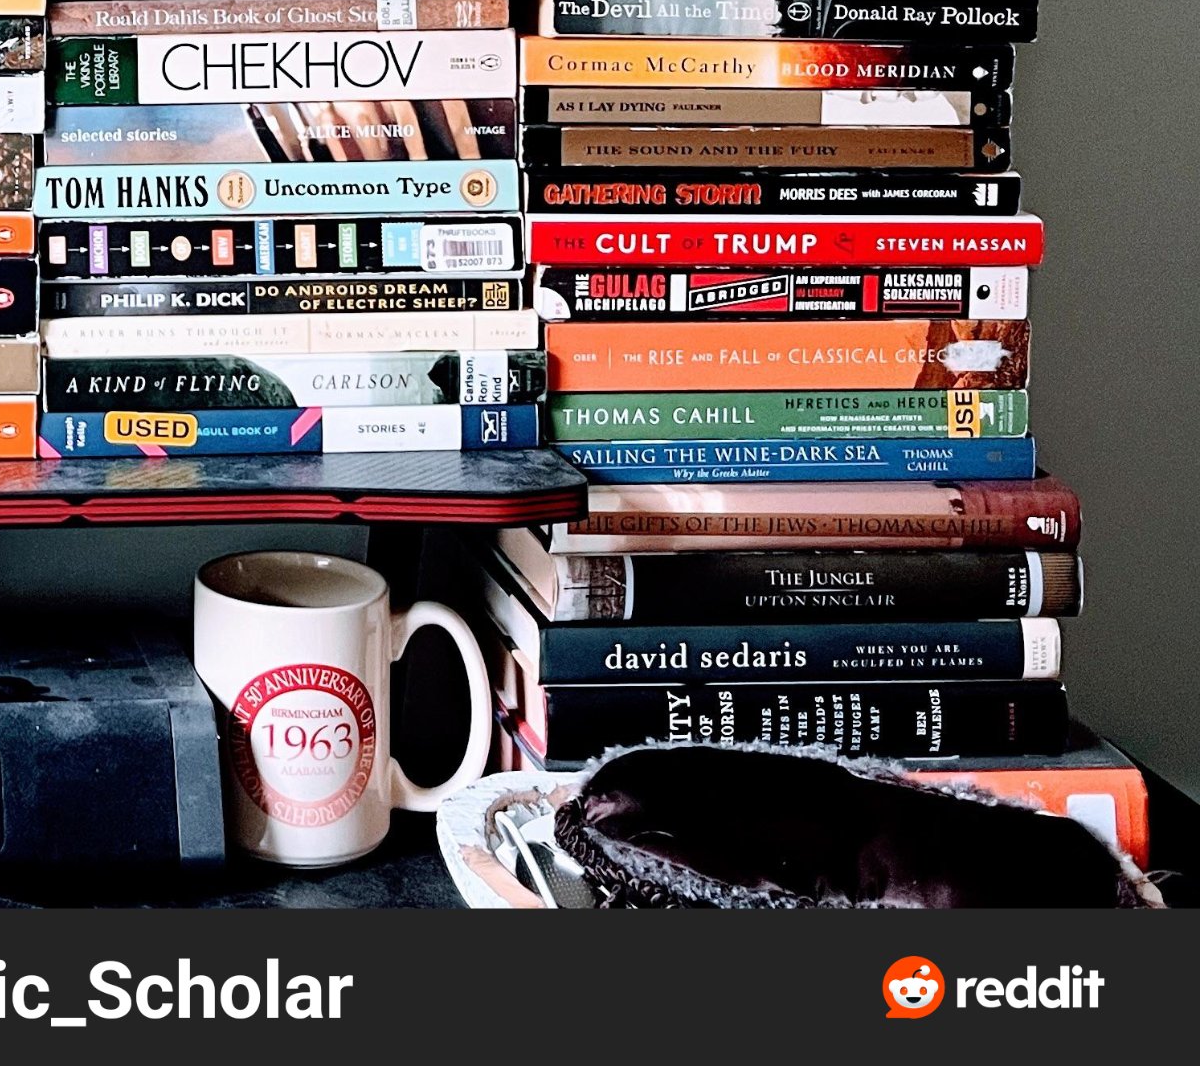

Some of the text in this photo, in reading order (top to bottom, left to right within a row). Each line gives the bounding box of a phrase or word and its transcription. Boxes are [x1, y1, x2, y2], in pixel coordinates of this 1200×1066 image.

[163, 40, 423, 91] CHEKHOV
[46, 176, 209, 209] TOM HANKS
[265, 178, 451, 199] Uncommon Type
[596, 234, 672, 255] CULT
[713, 234, 818, 255] TRUMP
[876, 237, 1027, 253] STEVEN HASSAN
[563, 407, 756, 426] THOMAS CAHILL
[605, 642, 807, 669] david sedaris
[272, 708, 343, 718] BIRMINGHAM
[261, 723, 353, 761] 1963
